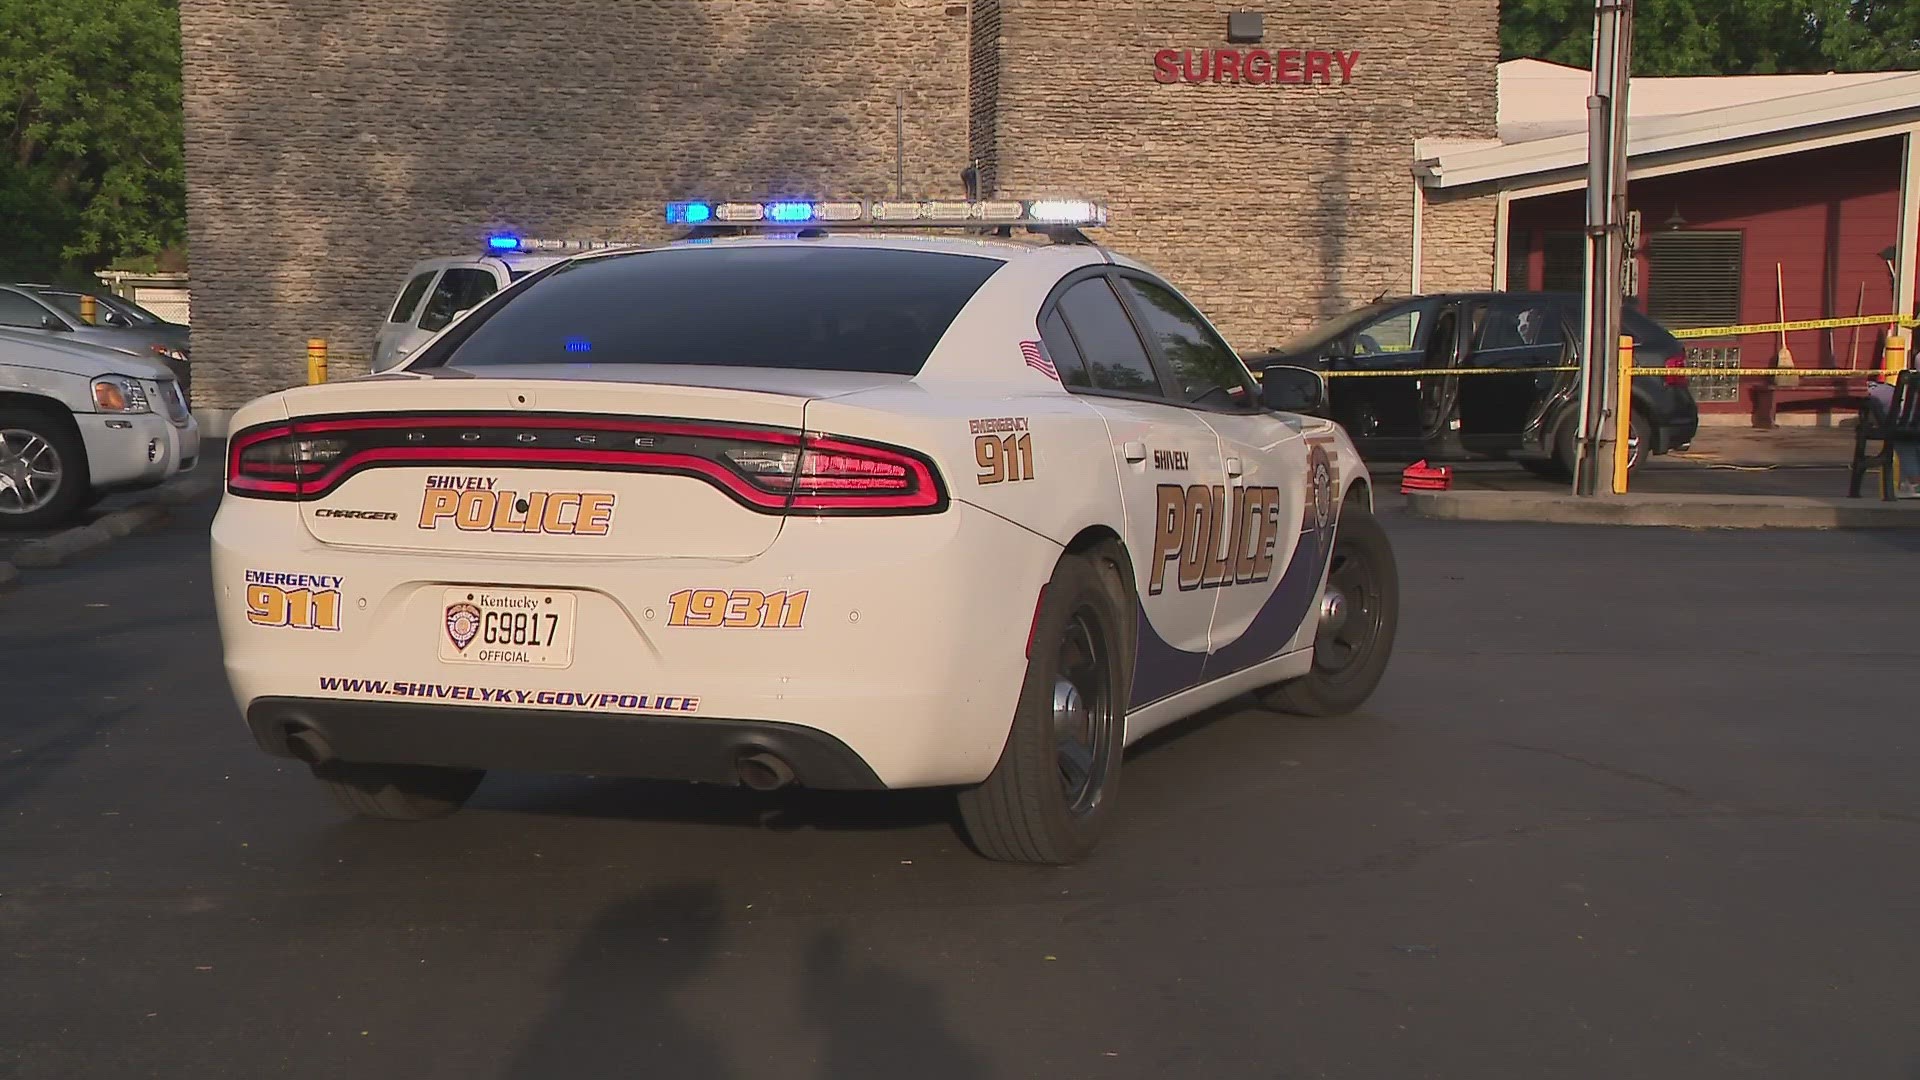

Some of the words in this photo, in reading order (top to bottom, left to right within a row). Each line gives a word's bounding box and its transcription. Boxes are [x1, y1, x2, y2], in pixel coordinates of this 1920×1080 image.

[1154, 49, 1360, 85] SURGERY
[406, 431, 655, 448] DODGE
[969, 417, 1028, 434] EMERGENCY
[975, 432, 1035, 485] 911
[1153, 450, 1189, 470] SHIVELY
[425, 475, 498, 490] SHIVELY
[315, 508, 398, 521] CHARGER
[418, 488, 615, 536] POLICE
[1149, 483, 1280, 596] POLICE
[245, 569, 344, 589] EMERGENCY
[246, 583, 342, 631] 911
[480, 595, 539, 611] Kentucky
[667, 589, 809, 628] 19311
[483, 611, 558, 647] G9817
[478, 650, 530, 662] OFFICIAL
[319, 676, 701, 712] WWW.SHIVELYKY.GOV/POLICE
